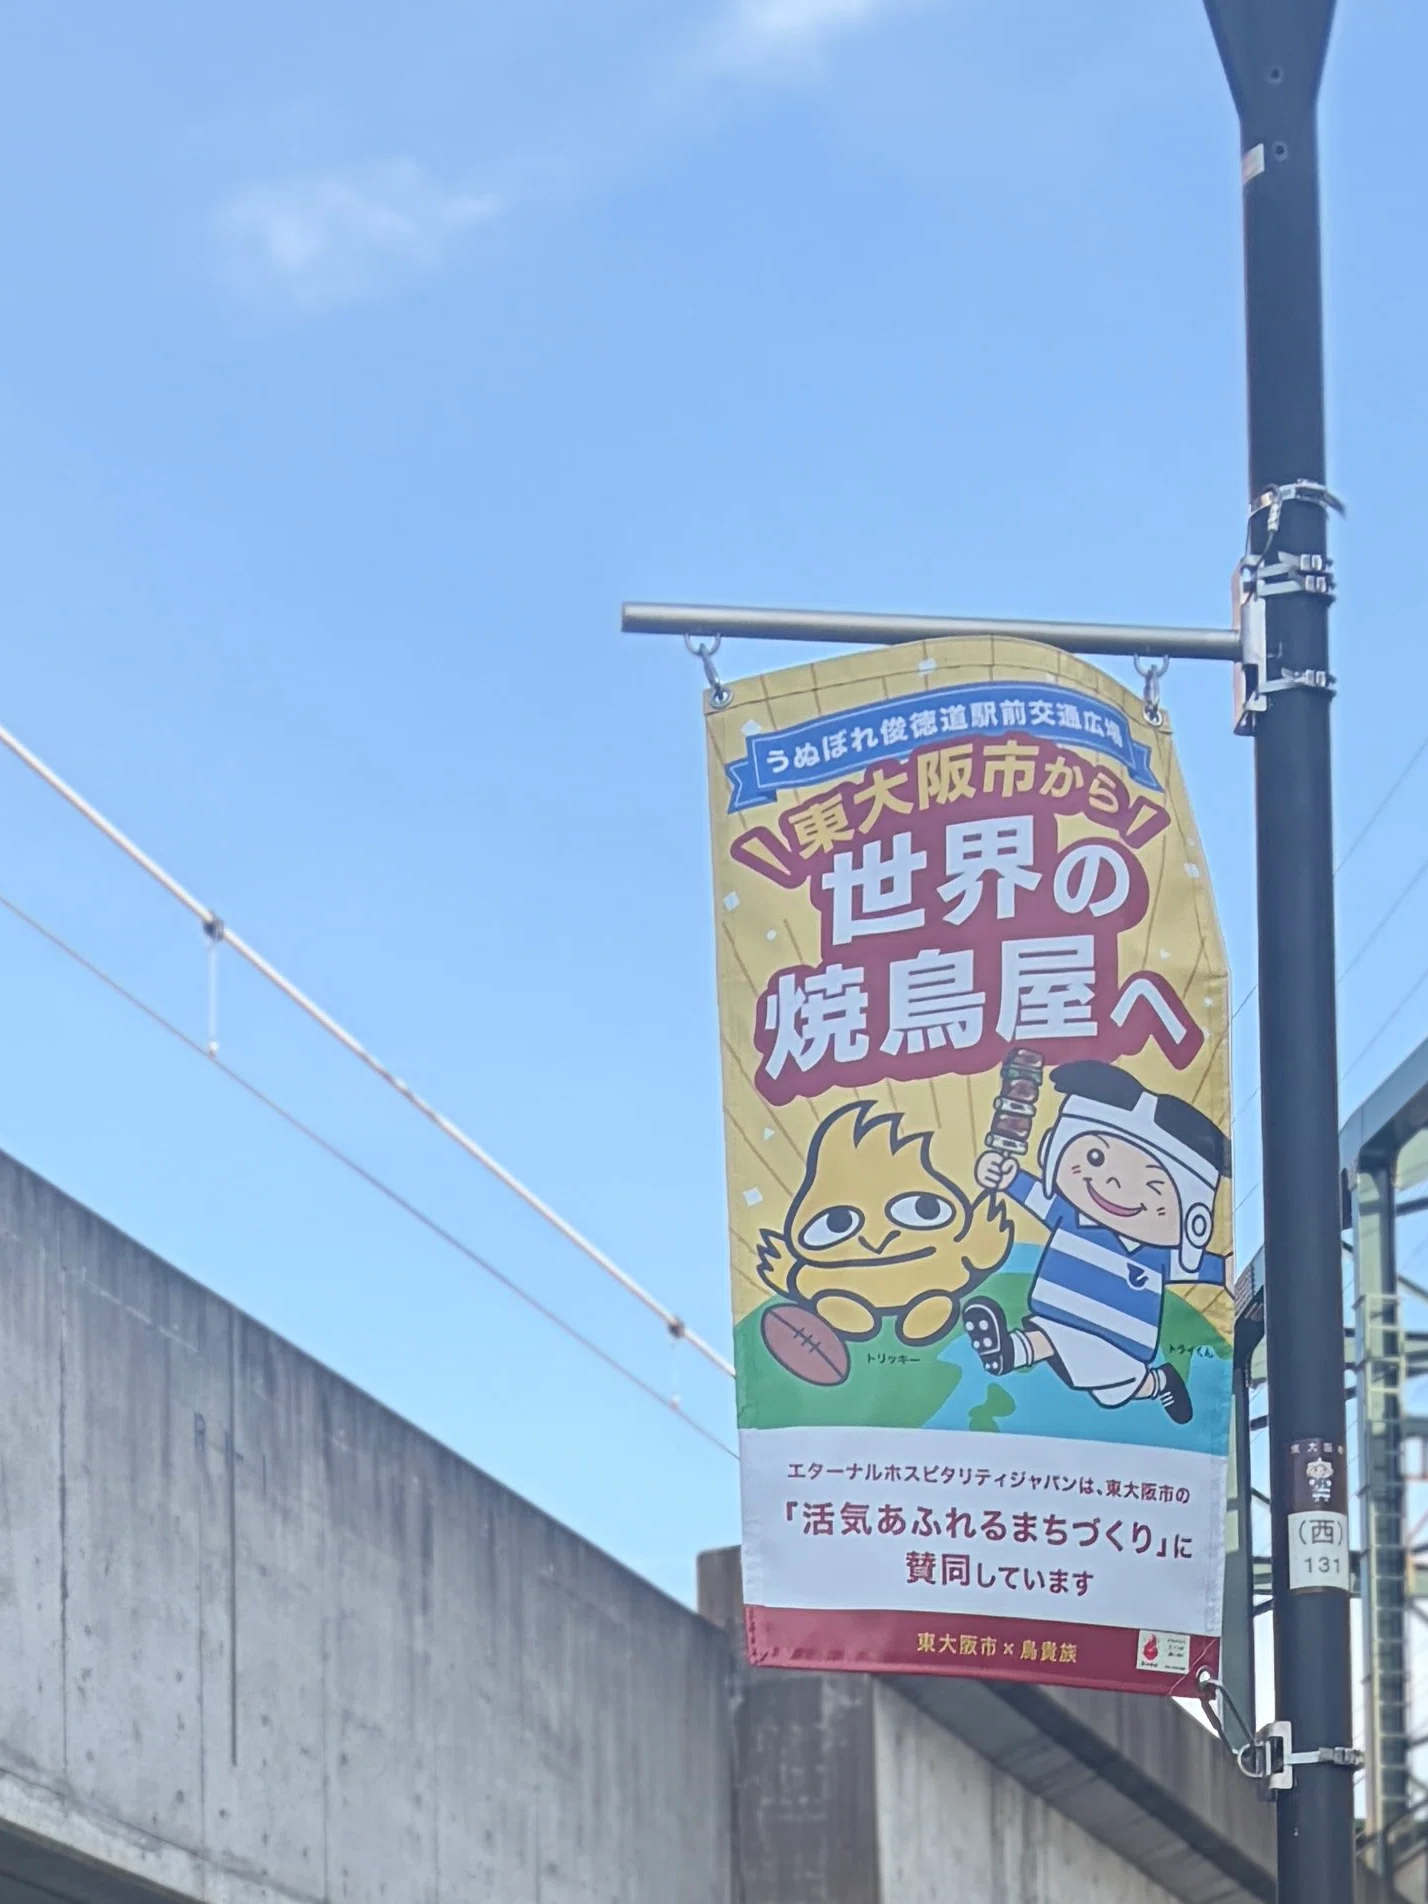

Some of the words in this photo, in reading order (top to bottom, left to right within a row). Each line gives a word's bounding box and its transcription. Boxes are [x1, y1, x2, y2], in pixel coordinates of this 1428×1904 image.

[766, 697, 1124, 774] うぬぼれ俊徳道駅前交通広場
[788, 739, 1121, 859] 東大阪市から
[821, 814, 1131, 946] 世界の
[764, 934, 1186, 1081] 焼鳥屋へ
[865, 1353, 921, 1366] トリッキー
[787, 1462, 1191, 1505] エターナルホスピタリティジャパンは、東大阪市の
[905, 1551, 1095, 1598] 賛同しています
[1304, 1556, 1341, 1574] 131
[916, 1631, 998, 1658] 東大阪市
